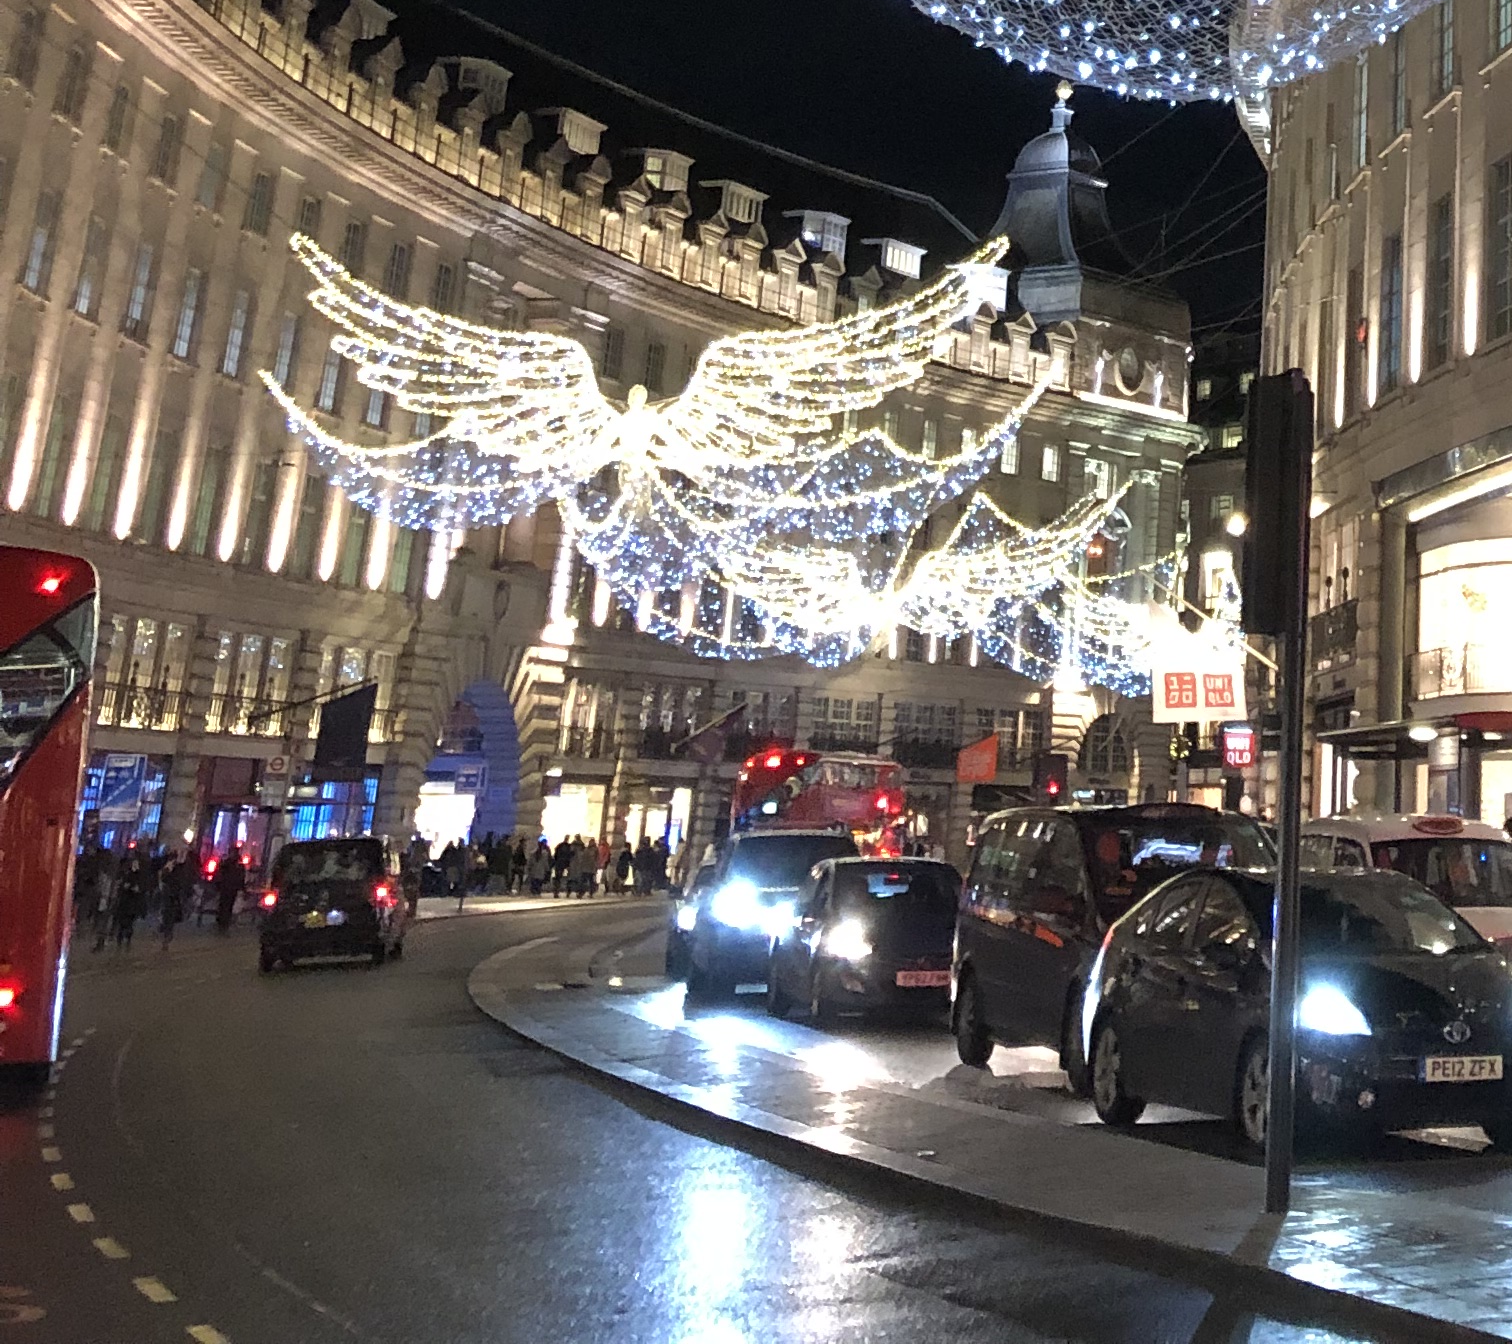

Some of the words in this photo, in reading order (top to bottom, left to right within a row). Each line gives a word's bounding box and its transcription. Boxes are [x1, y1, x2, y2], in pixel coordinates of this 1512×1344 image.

[1205, 677, 1229, 690] UNI
[1208, 691, 1232, 705] QLO
[1226, 737, 1250, 750] UNI
[1226, 751, 1251, 766] QLO
[1431, 1060, 1465, 1078] PE12
[1469, 1058, 1497, 1077] ZFX
